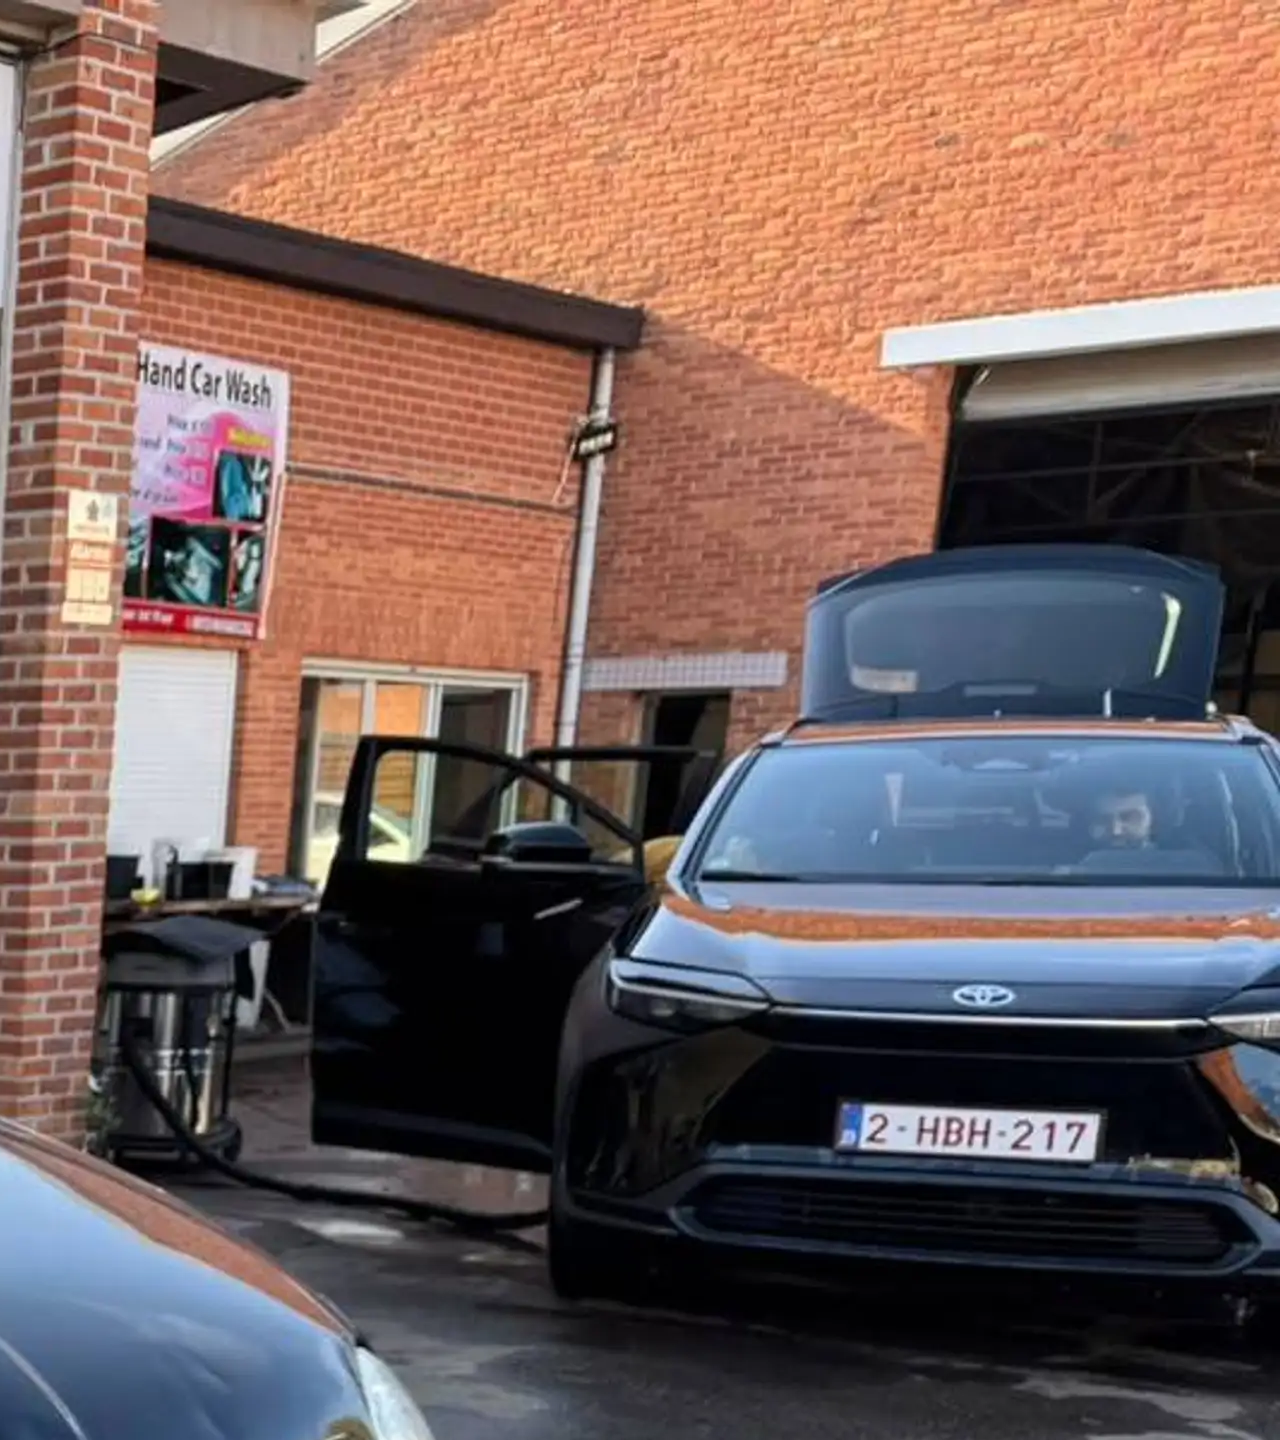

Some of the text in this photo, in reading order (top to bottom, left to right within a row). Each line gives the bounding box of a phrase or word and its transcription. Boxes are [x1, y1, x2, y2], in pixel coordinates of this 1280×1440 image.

[137, 350, 272, 409] Hand Car Wash
